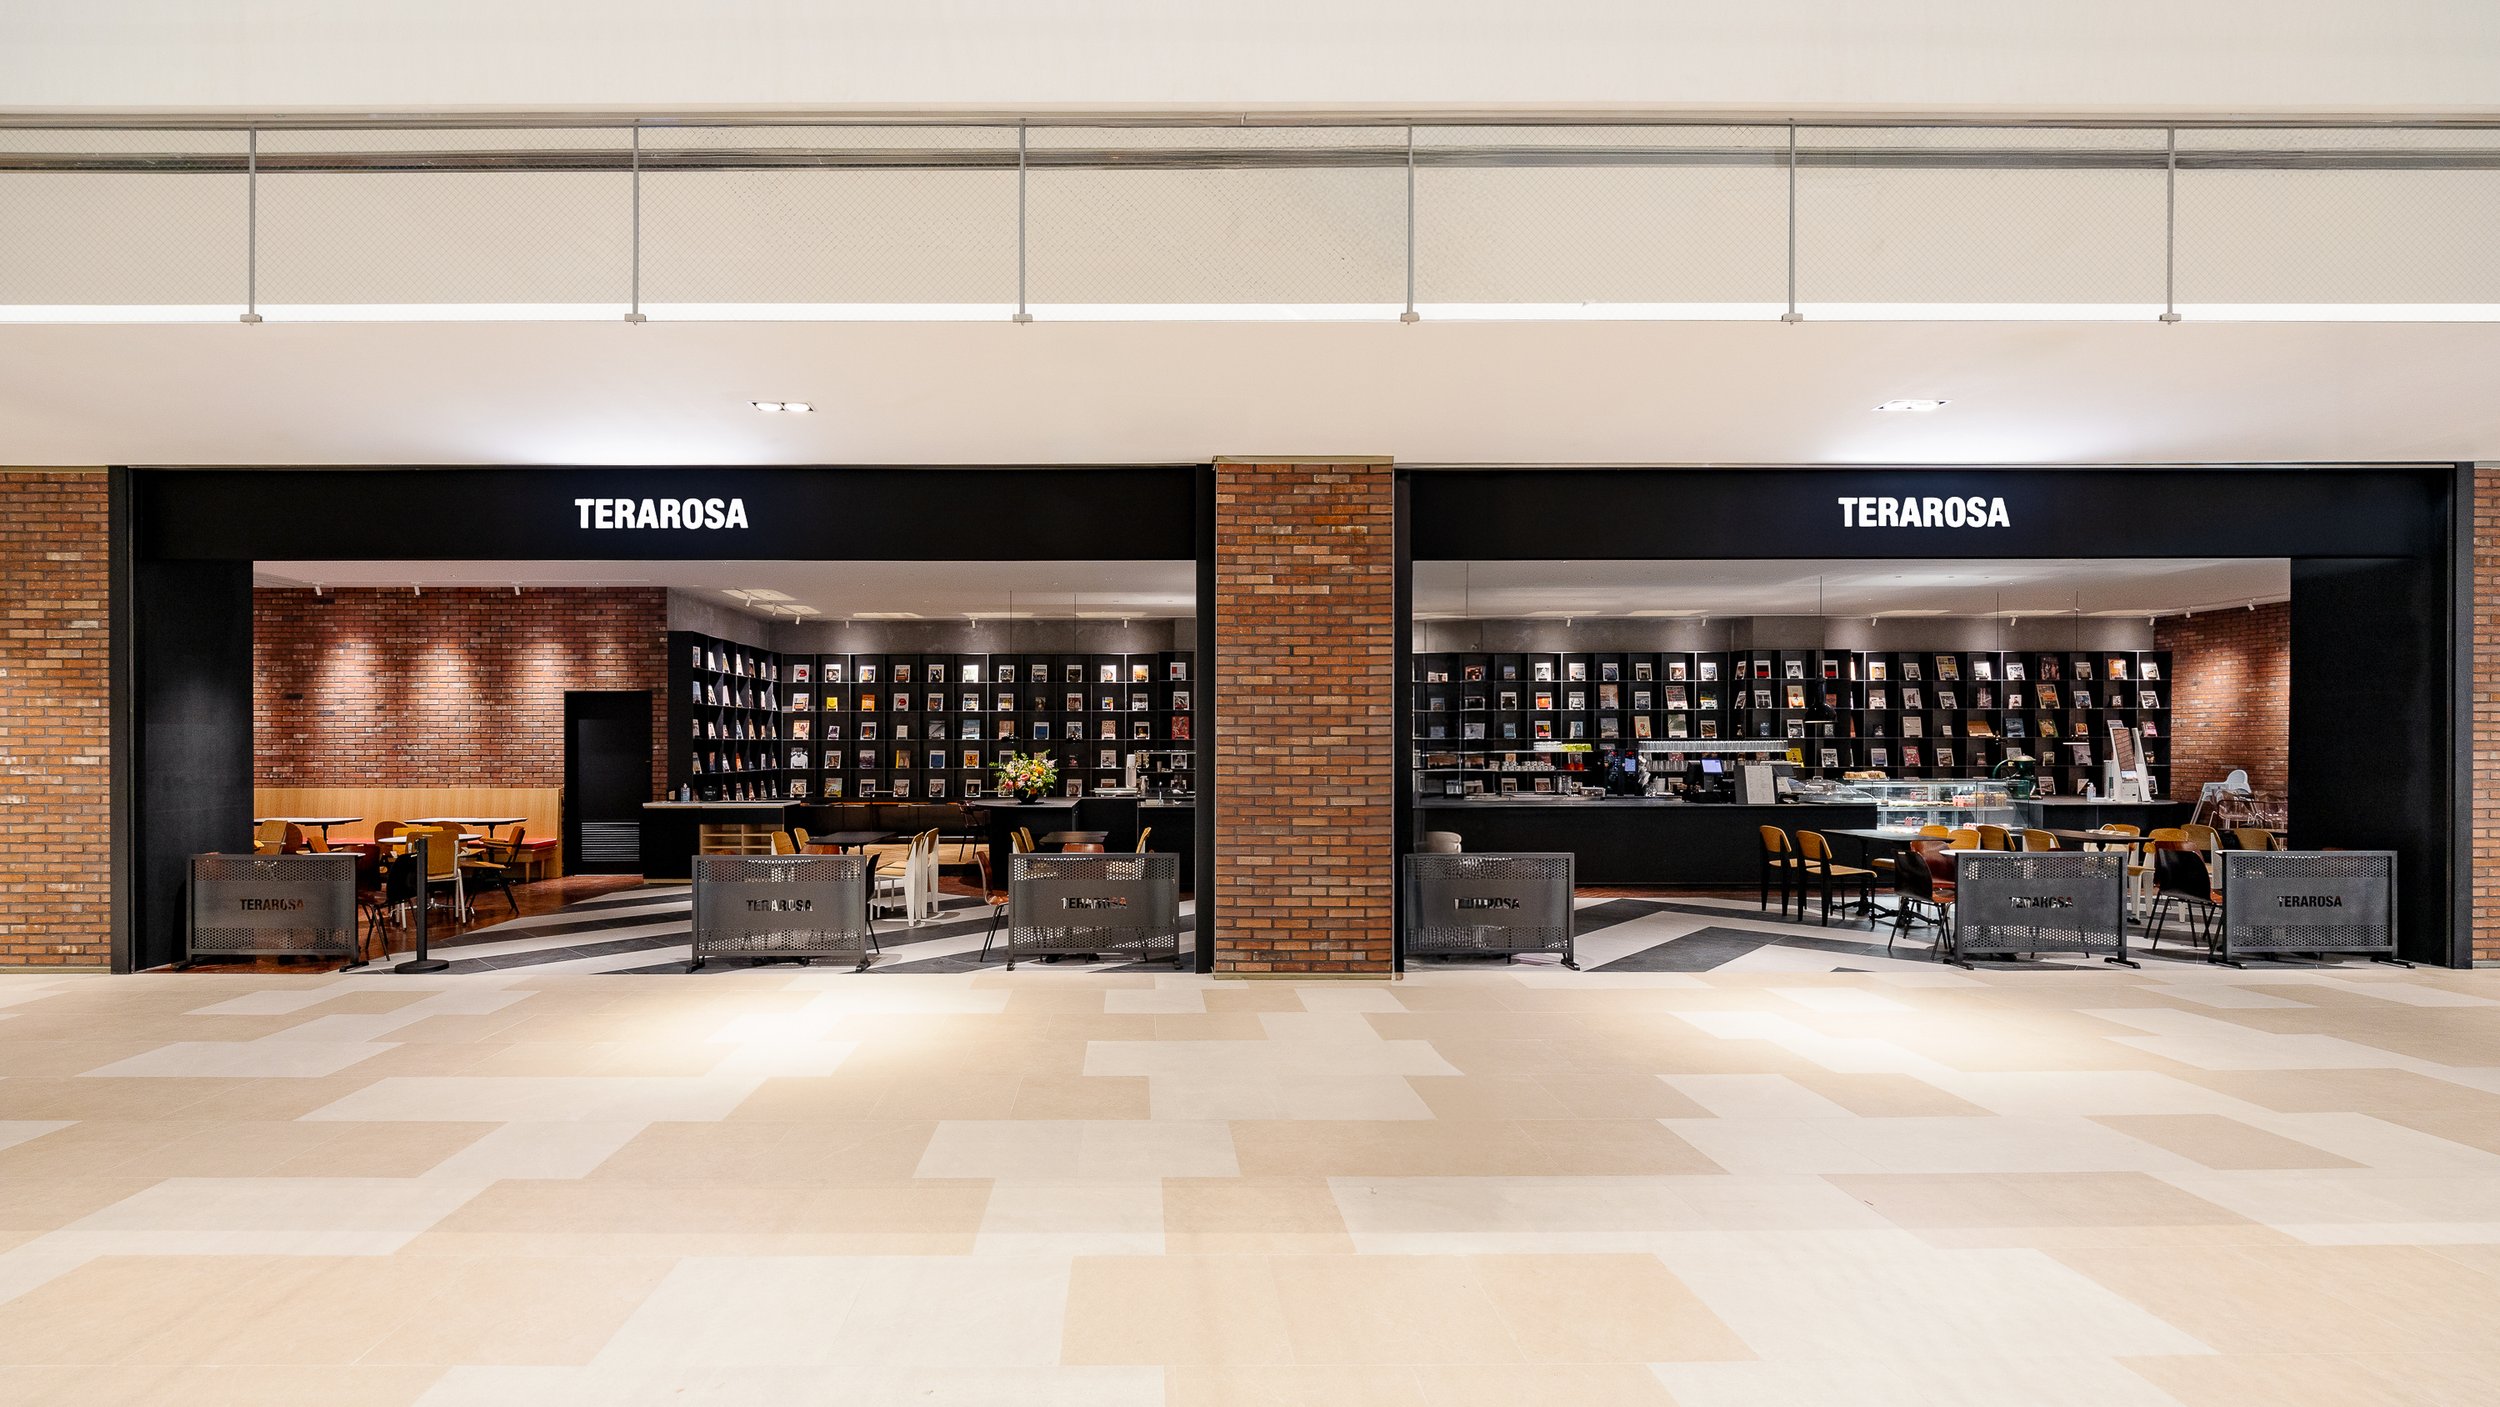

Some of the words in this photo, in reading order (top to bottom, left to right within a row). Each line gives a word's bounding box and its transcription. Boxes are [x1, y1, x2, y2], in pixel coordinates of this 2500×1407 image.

[575, 498, 748, 529] TERAROSA
[1838, 496, 2010, 528] TERAROSA
[240, 898, 304, 910] TERAROSA
[746, 899, 813, 911] TERAROSA
[2277, 895, 2342, 907] TERAROSA
